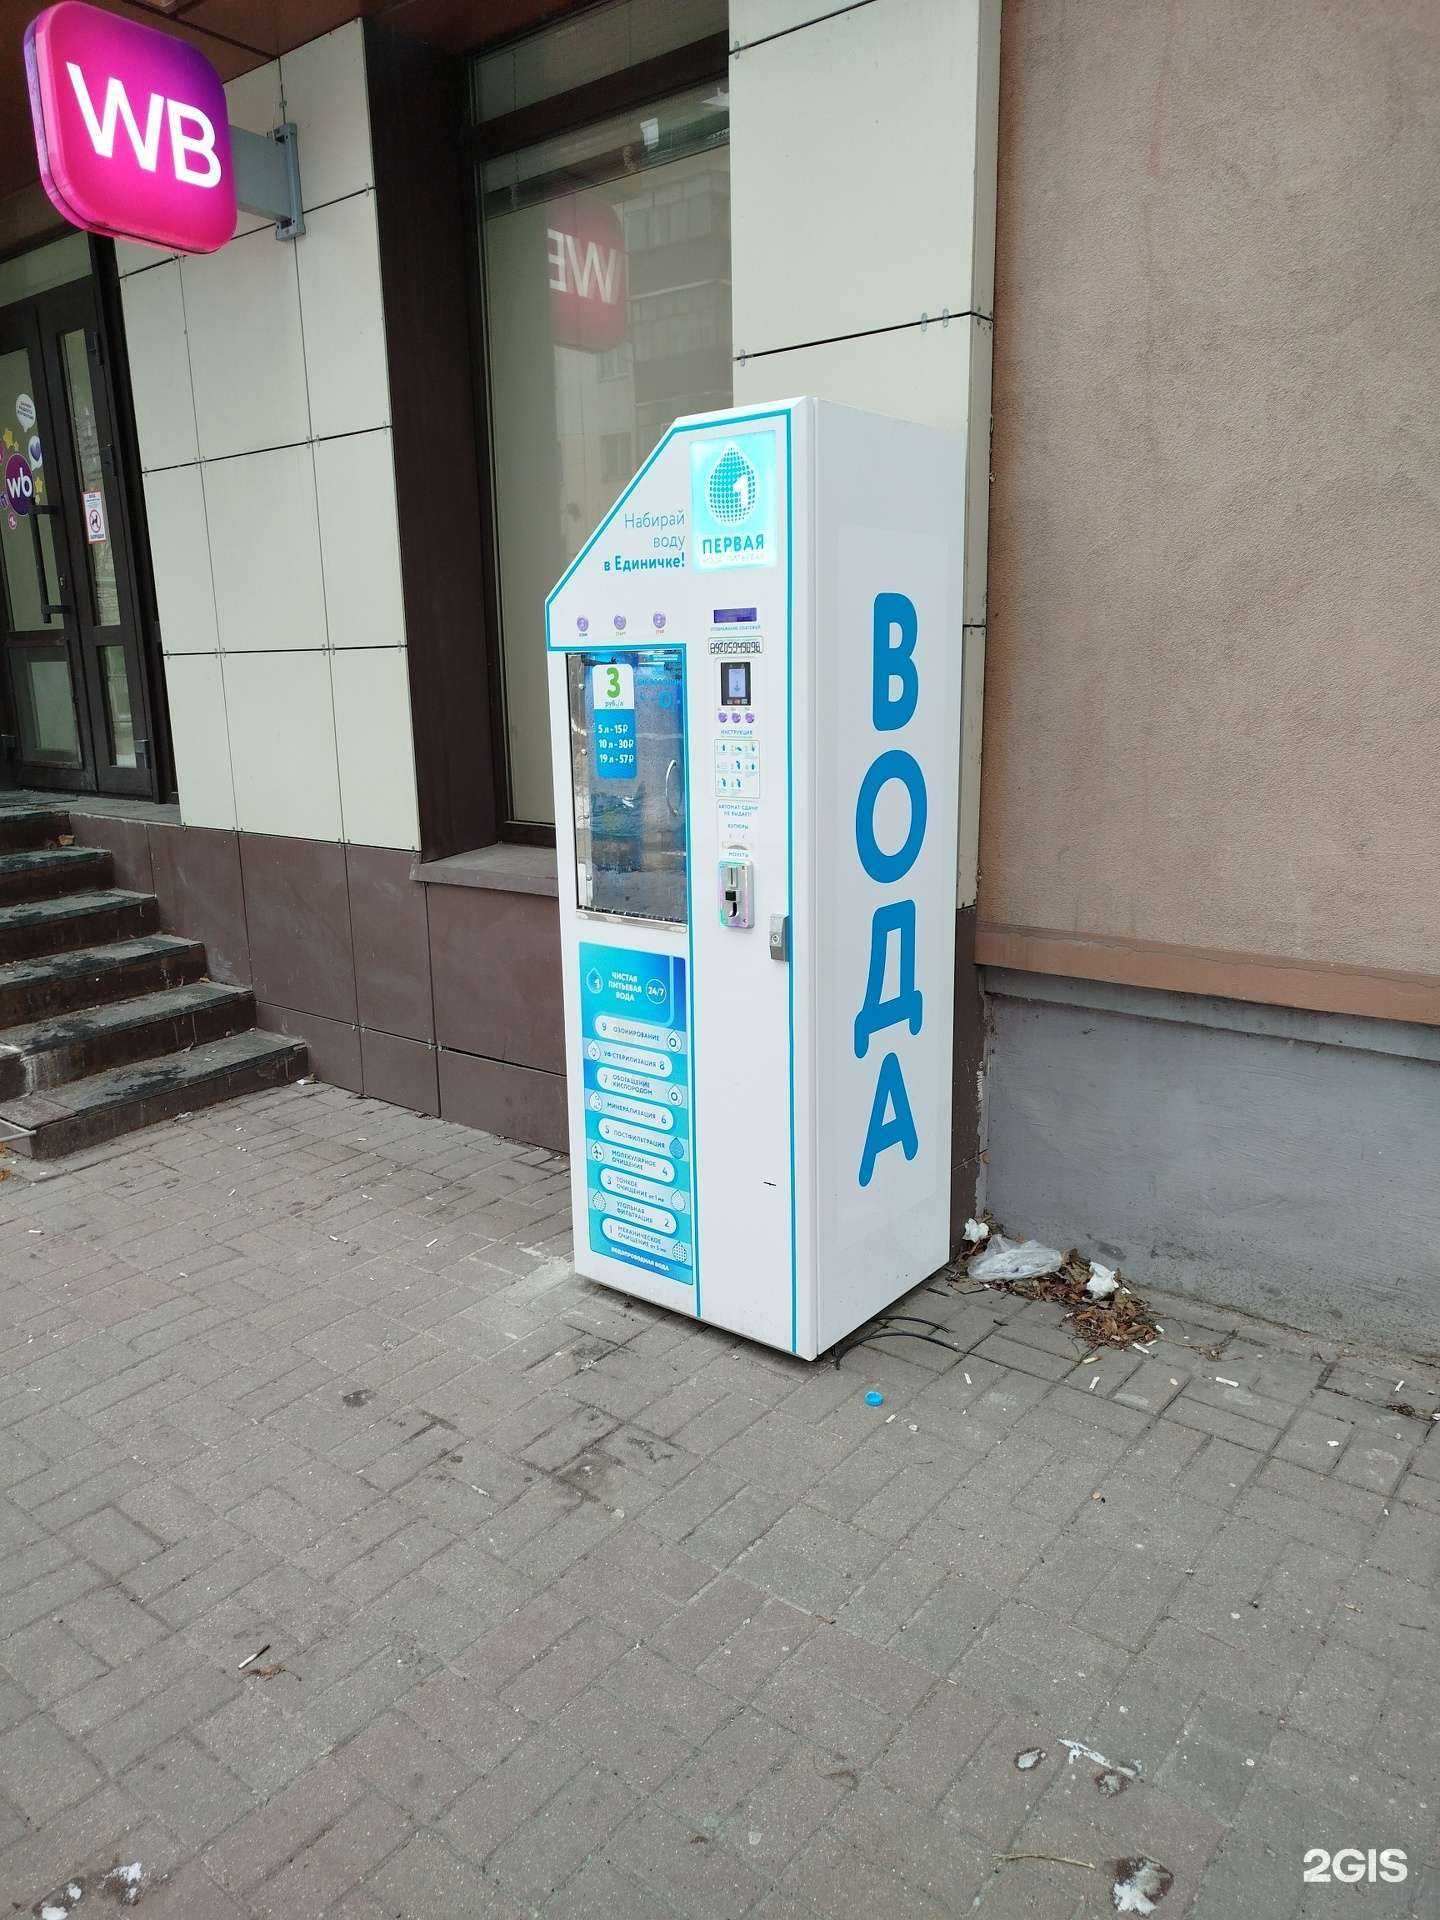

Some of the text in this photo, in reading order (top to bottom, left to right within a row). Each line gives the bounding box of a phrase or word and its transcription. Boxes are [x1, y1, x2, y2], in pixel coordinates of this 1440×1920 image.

[66, 61, 222, 189] WB
[6, 467, 33, 498] wb
[624, 510, 685, 530] Набирай
[653, 535, 686, 551] воду
[703, 533, 764, 555] ПЕРВАЯ
[604, 560, 611, 571] в
[615, 552, 685, 572] Единичке!
[606, 667, 620, 698] 3
[598, 724, 603, 734] 5
[599, 739, 607, 748] 10
[600, 754, 608, 763] 19
[854, 592, 928, 1187] ВОДА
[611, 971, 638, 983] ЧИСТАЯ
[608, 980, 642, 994] ПИТЬЕВАЯ
[647, 986, 664, 997] 24/7
[615, 992, 635, 1002] ВОДА
[601, 1023, 660, 1042] 9 ОЗОНИРОВАНИЕ
[612, 1053, 657, 1068] СТЕРИЛИЗАЦИЯ
[659, 1061, 665, 1071] 8
[612, 1074, 650, 1088] ОБОГАЩЕНИЕ
[612, 1082, 653, 1095] КИСЛОРОДОМ
[607, 1102, 667, 1124] МИНЕРАЛИЗАЦИЯ 6
[605, 1125, 665, 1149] 5 ПОСТФИЛЬТРАЦИЯ
[611, 1149, 656, 1168] МОЛЕКУЛЯРНОЕ
[611, 1157, 644, 1171] ОЧИЩЕНИЕ
[662, 1168, 668, 1177] 4
[607, 1176, 612, 1185] 3
[616, 1176, 638, 1188] ТОНКОЕ
[616, 1200, 645, 1214] УГОЛЬНАЯ
[664, 1218, 670, 1228] 2
